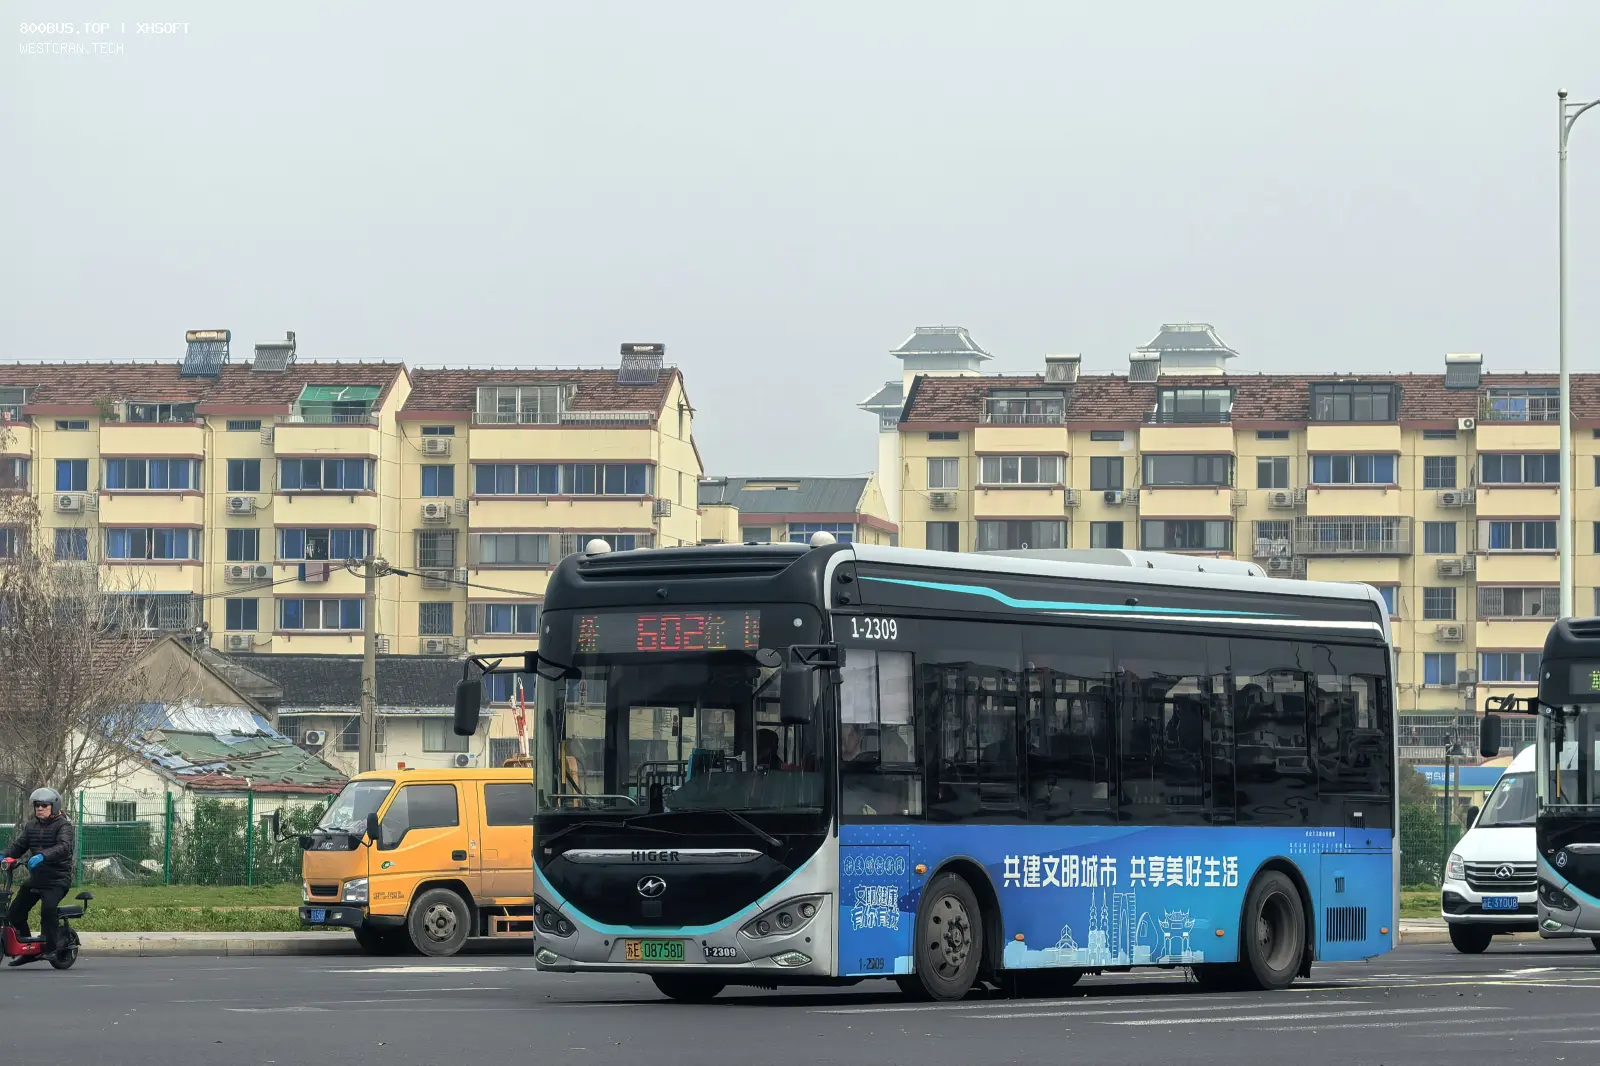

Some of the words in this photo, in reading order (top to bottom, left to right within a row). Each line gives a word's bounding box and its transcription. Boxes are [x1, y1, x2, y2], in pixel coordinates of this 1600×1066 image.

[851, 617, 898, 640] 1-2309
[631, 850, 680, 861] HIGER
[1003, 854, 1117, 888] 共建文明城市
[1130, 854, 1238, 888] 共享美好生活
[853, 884, 899, 907] 文明健康
[851, 905, 900, 931] 有你有我
